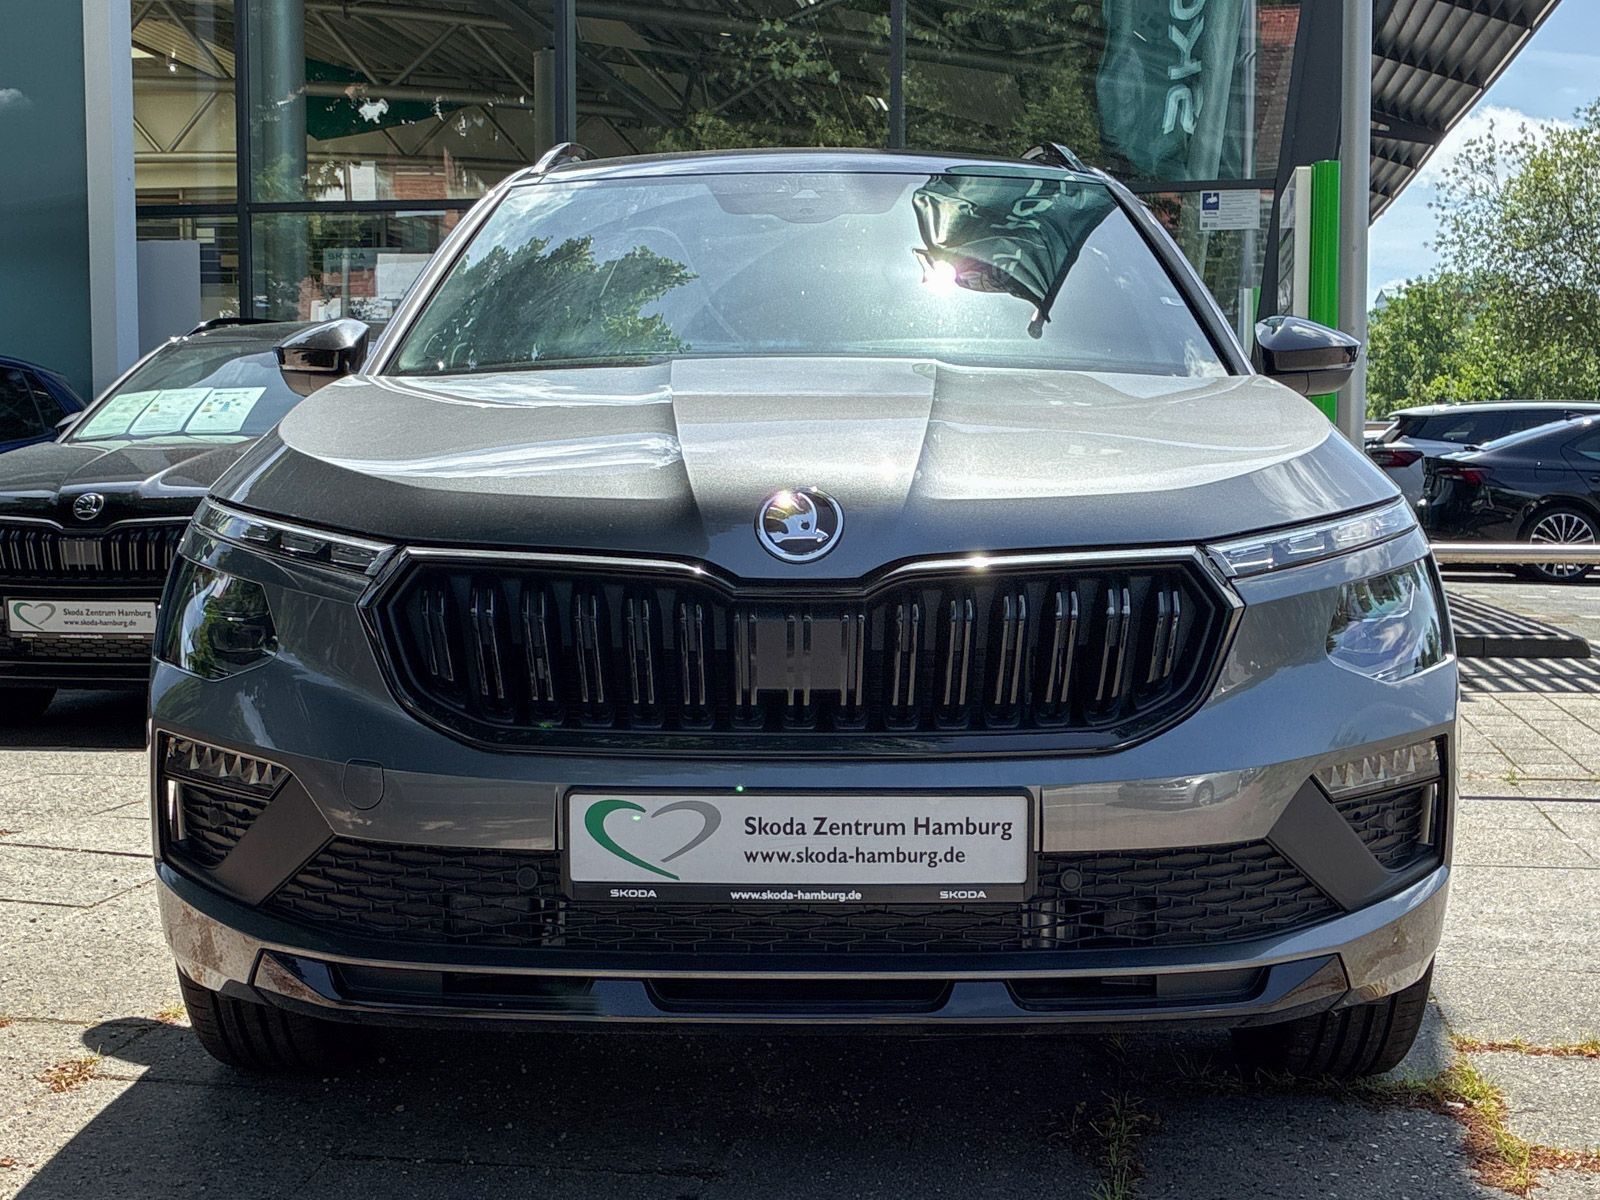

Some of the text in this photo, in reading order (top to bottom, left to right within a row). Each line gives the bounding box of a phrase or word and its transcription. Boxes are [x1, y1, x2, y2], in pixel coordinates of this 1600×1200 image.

[63, 608, 152, 619] Skoda Zentrum Hamburg
[63, 618, 137, 628] www.skoda-hamburg.de
[744, 816, 1013, 841] Skoda Zentrum Hamburg
[743, 845, 966, 869] www.skoda-hamburg.de
[609, 888, 658, 898] SKODA
[729, 889, 862, 902] www.skoda-hamburg.de
[938, 889, 988, 899] SKODA
